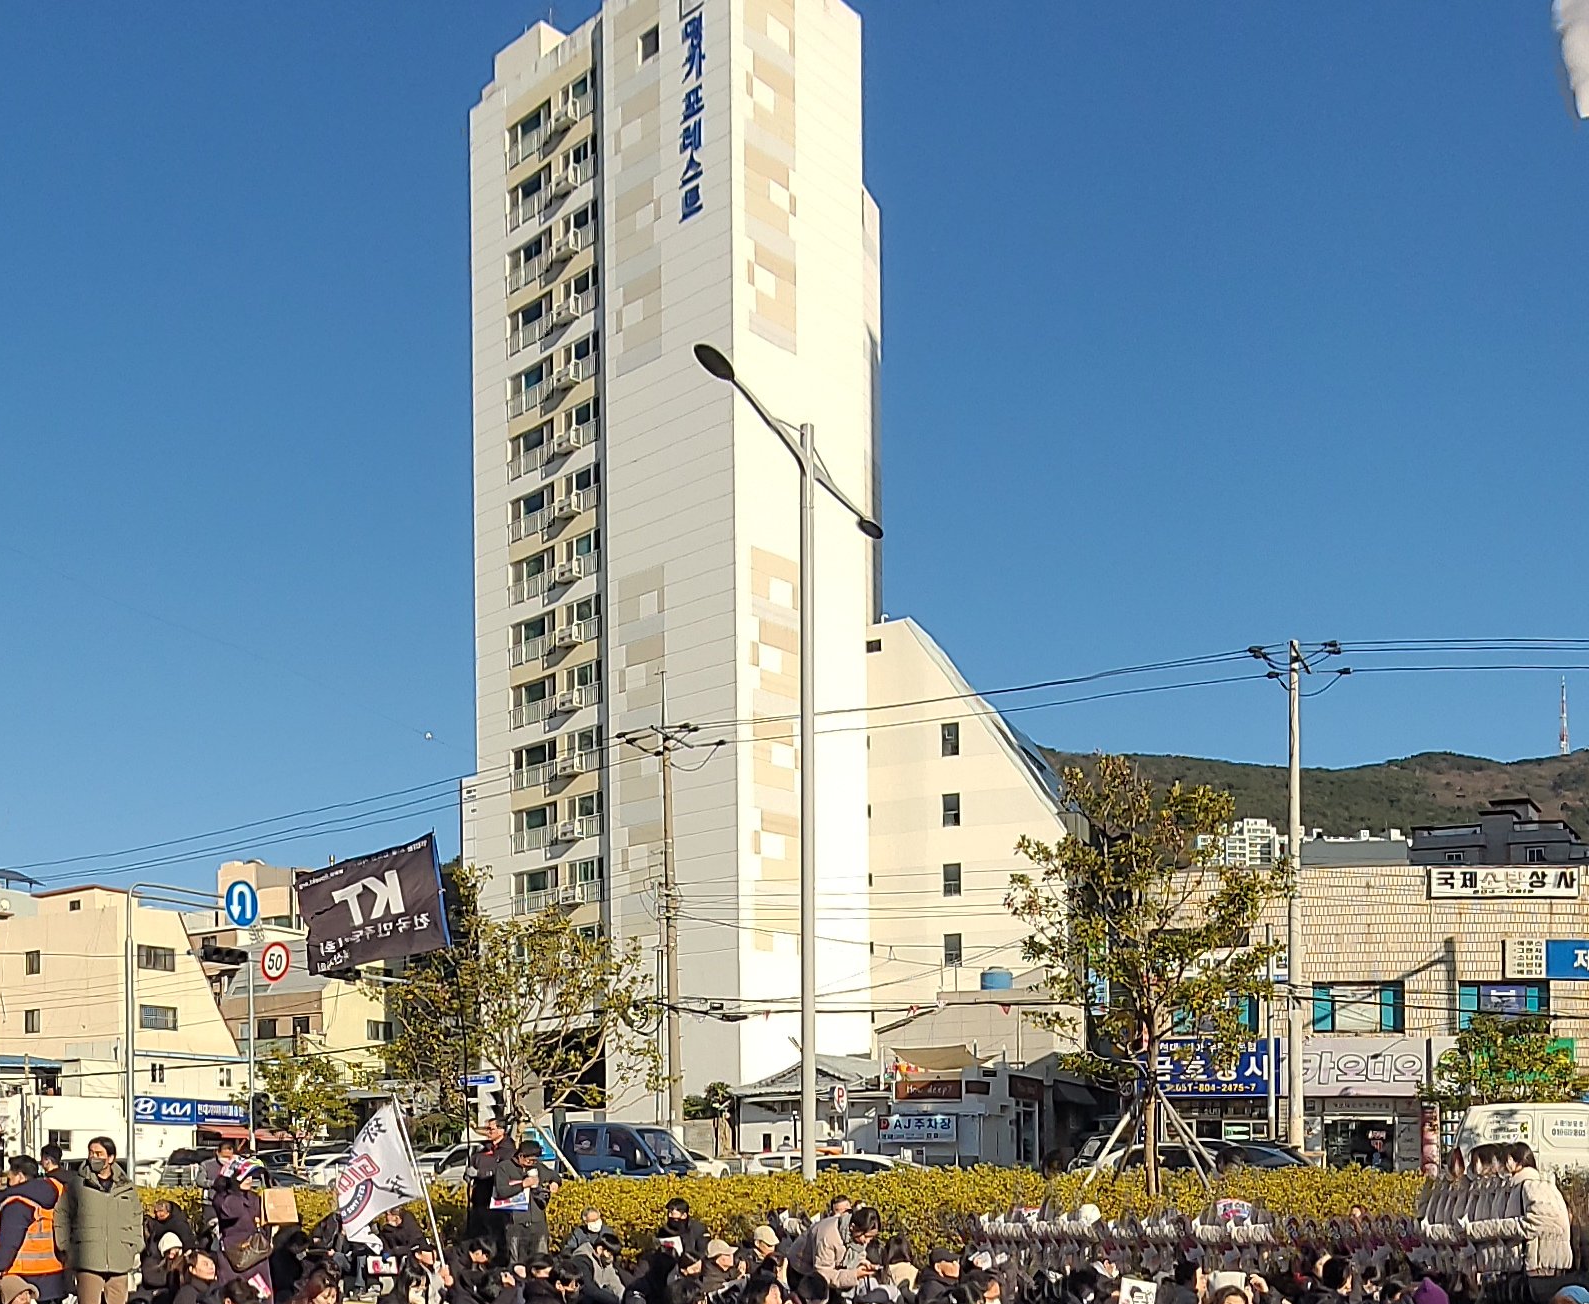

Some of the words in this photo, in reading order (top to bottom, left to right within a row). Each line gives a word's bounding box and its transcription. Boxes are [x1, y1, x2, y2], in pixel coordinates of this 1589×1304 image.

[678, 86, 706, 223] 포레스트
[267, 953, 283, 971] 50
[161, 1102, 193, 1116] KIA
